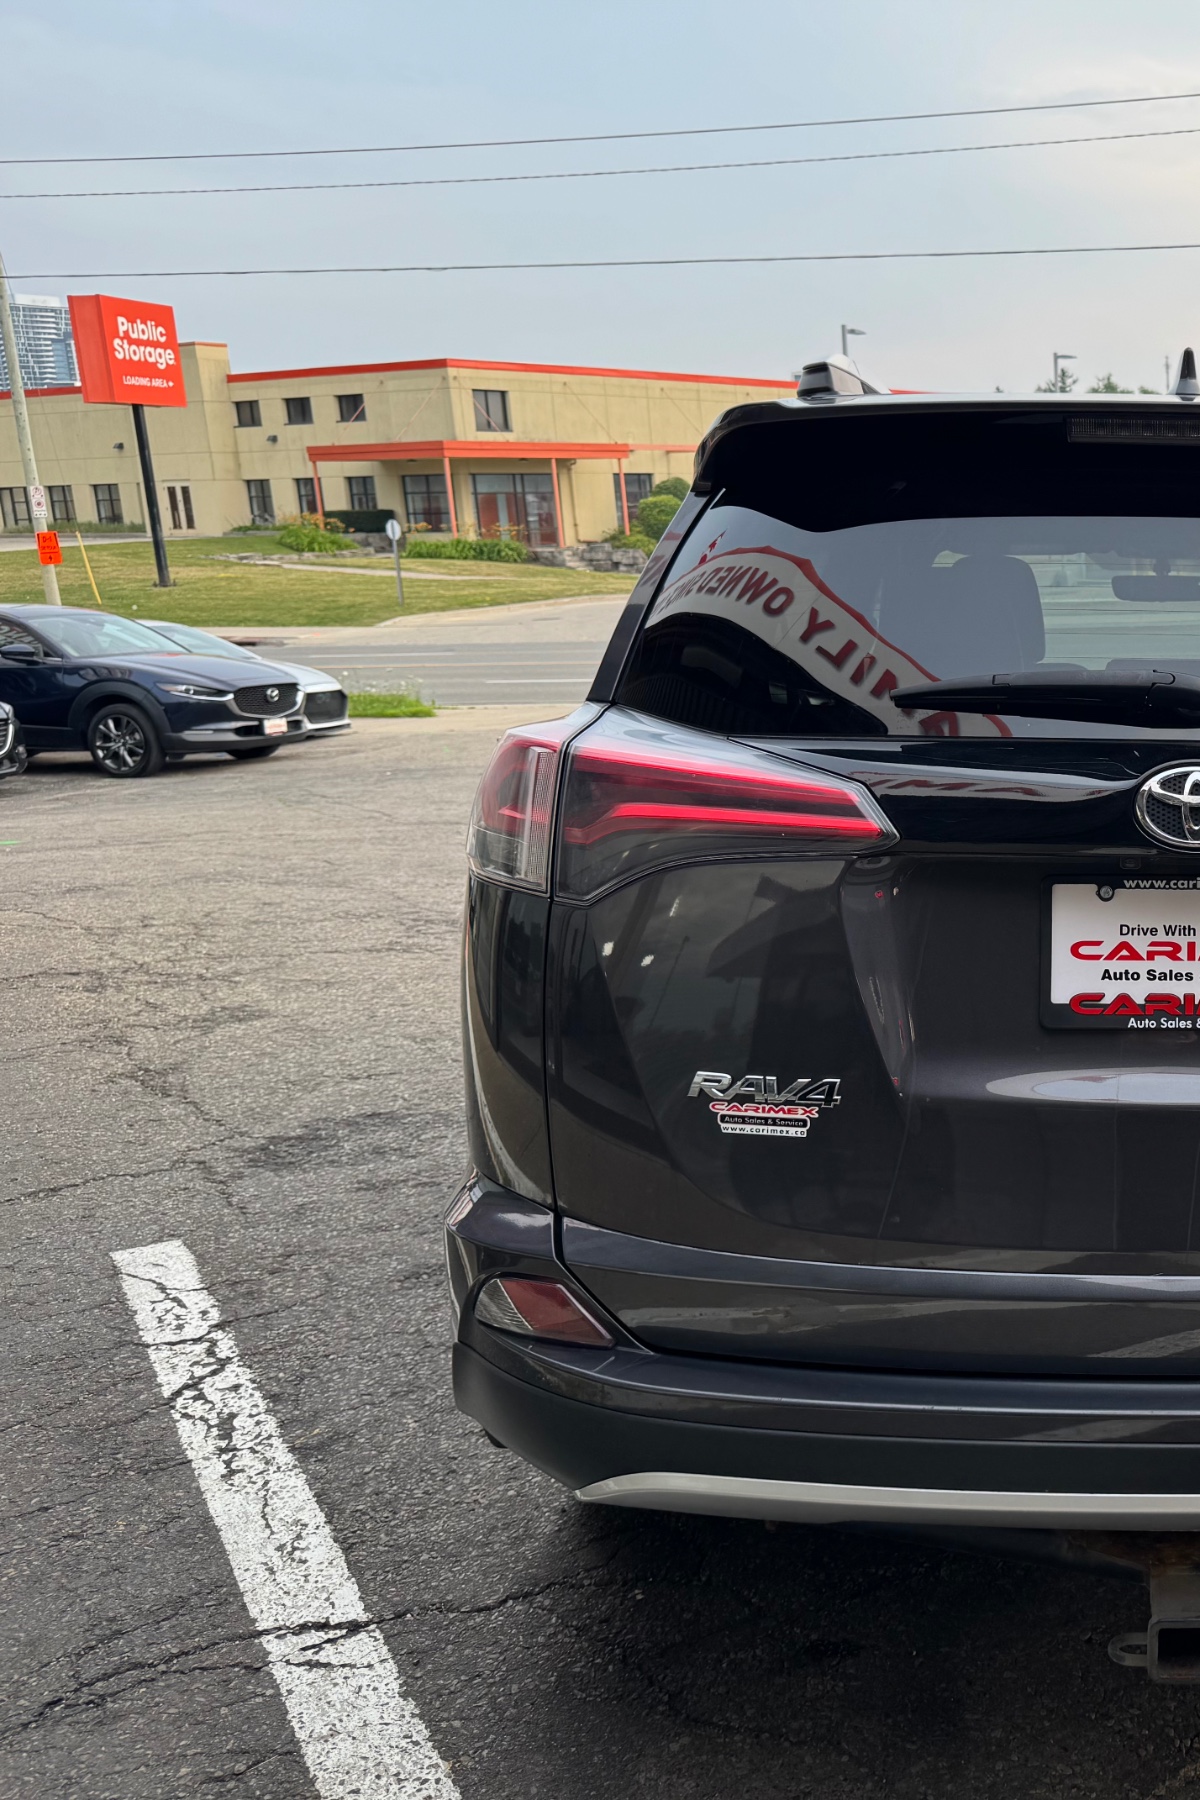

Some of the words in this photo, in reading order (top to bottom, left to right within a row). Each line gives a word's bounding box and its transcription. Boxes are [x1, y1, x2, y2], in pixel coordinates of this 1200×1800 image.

[117, 315, 167, 343] Public
[113, 338, 175, 370] Storage
[122, 375, 151, 387] LOADING
[151, 378, 168, 388] AREA
[1119, 923, 1158, 937] Drive
[1163, 923, 1197, 937] With
[1100, 968, 1141, 982] Auto
[1146, 969, 1194, 982] Sales
[1127, 1017, 1157, 1029] Auto
[1160, 1018, 1193, 1029] Sales
[687, 1070, 842, 1109] RAV4
[710, 1102, 819, 1117] CARIMEX
[724, 1116, 744, 1124] Auto
[744, 1117, 766, 1125] Sales
[775, 1118, 804, 1126] Service
[722, 1125, 806, 1136] www.carimex.ca
